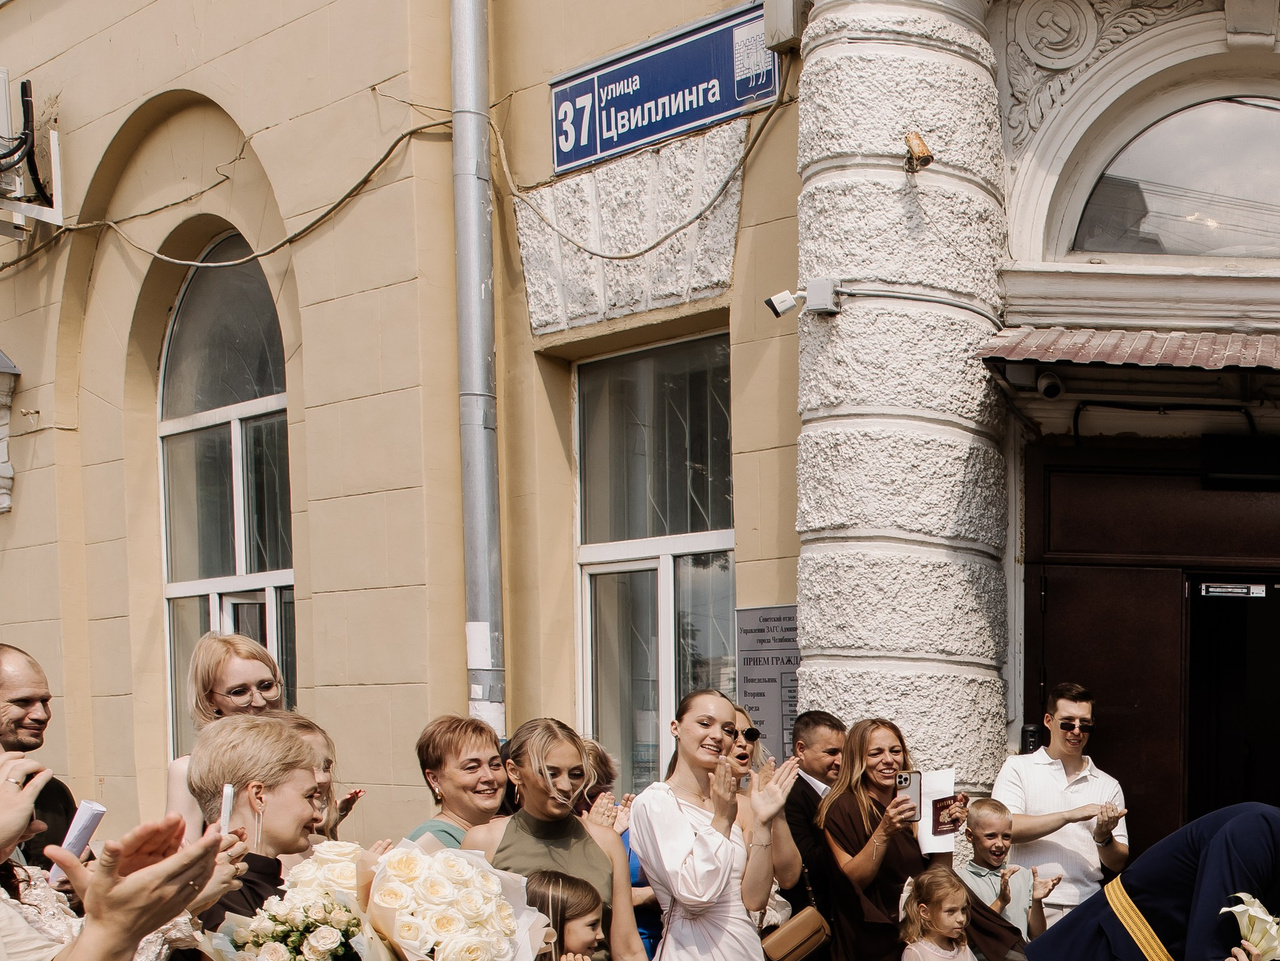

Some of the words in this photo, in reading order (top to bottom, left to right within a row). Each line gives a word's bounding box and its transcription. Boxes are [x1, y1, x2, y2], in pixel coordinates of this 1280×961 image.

[600, 74, 640, 107] улица
[601, 79, 720, 142] Цвиллинга
[557, 93, 593, 152] 37
[759, 615, 782, 623] Советский
[739, 627, 766, 636] Управления
[766, 625, 780, 634] ЗАГС
[743, 657, 770, 666] ПРИЕМ
[743, 676, 778, 684] Понедельник
[743, 690, 766, 699] Вторник
[743, 704, 760, 713] Среда
